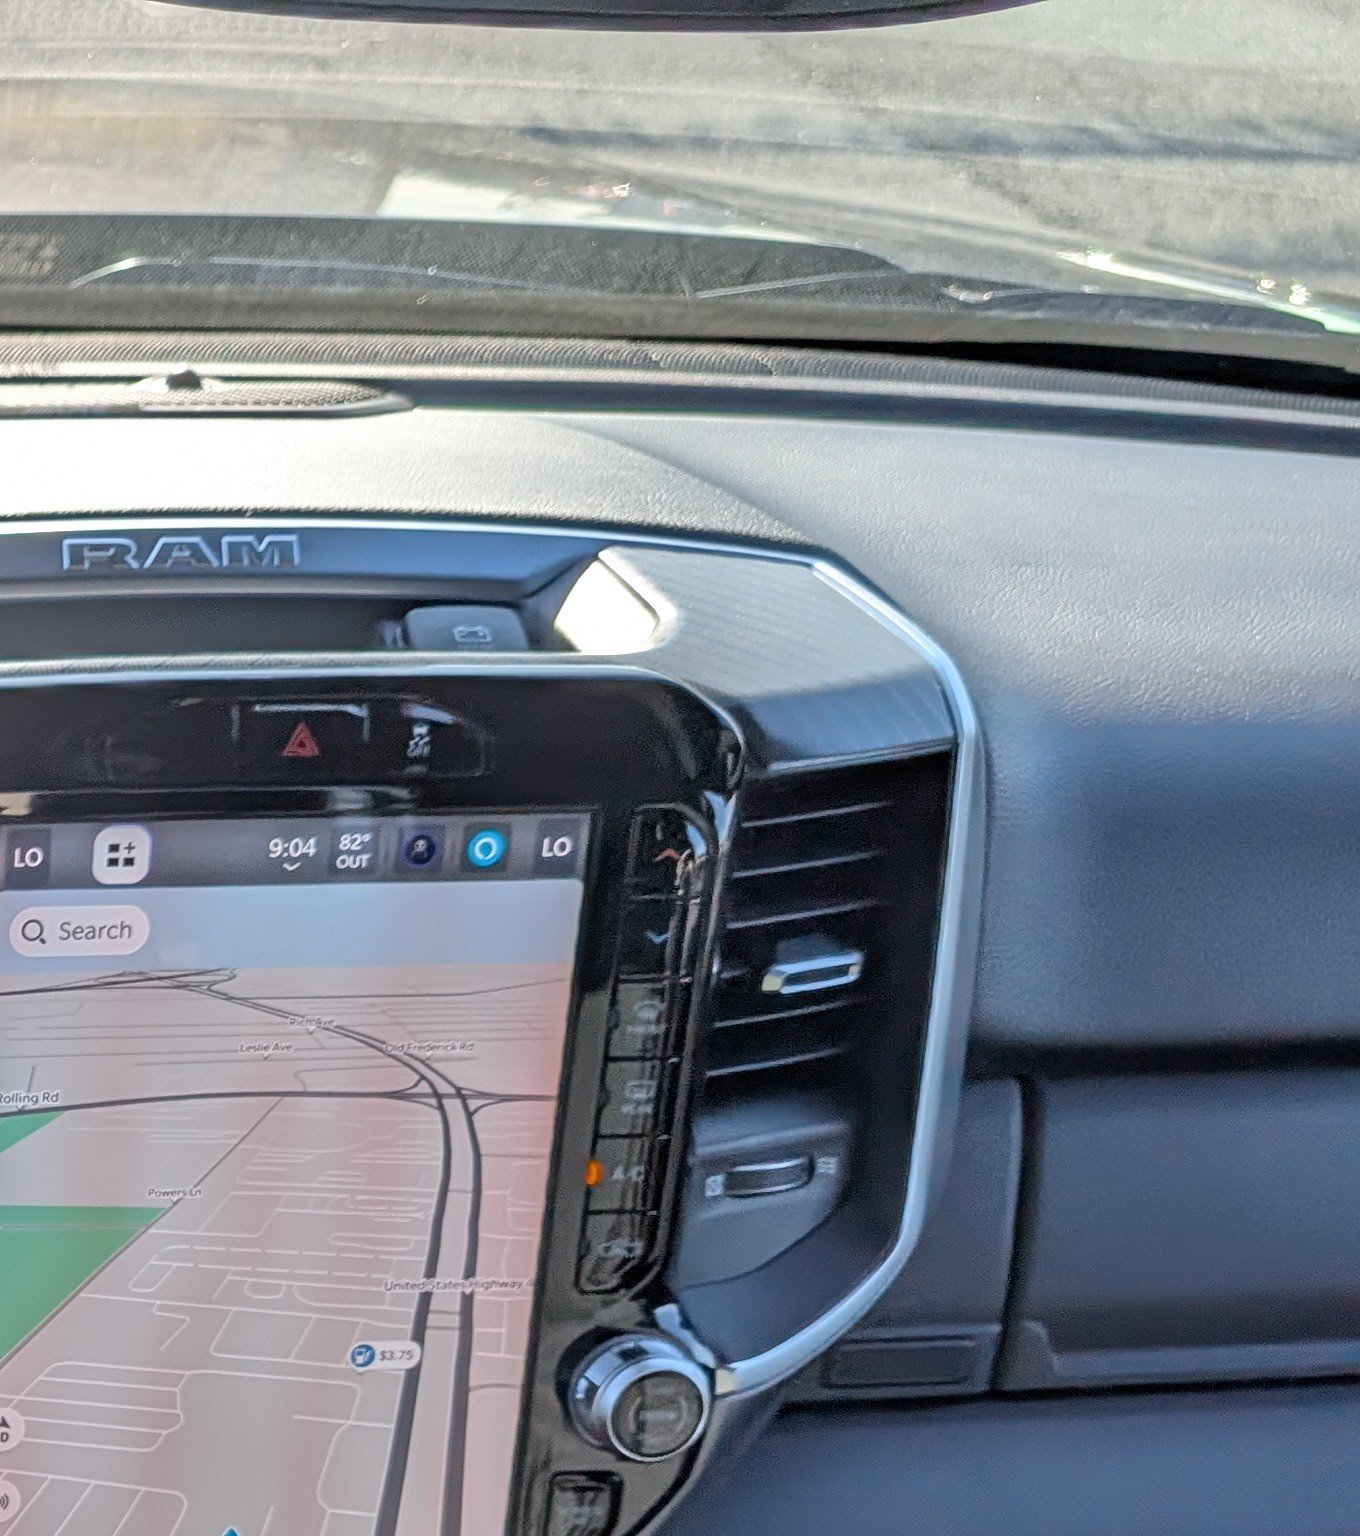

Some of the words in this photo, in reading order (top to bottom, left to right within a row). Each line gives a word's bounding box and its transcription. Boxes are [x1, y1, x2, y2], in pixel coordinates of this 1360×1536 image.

[61, 534, 301, 570] RAM
[268, 836, 317, 859] 9:04
[339, 832, 372, 851] 82°
[541, 836, 573, 857] LO
[13, 846, 44, 869] LO
[336, 853, 370, 870] OUT
[58, 918, 132, 942] Search
[41, 1091, 60, 1104] Rd
